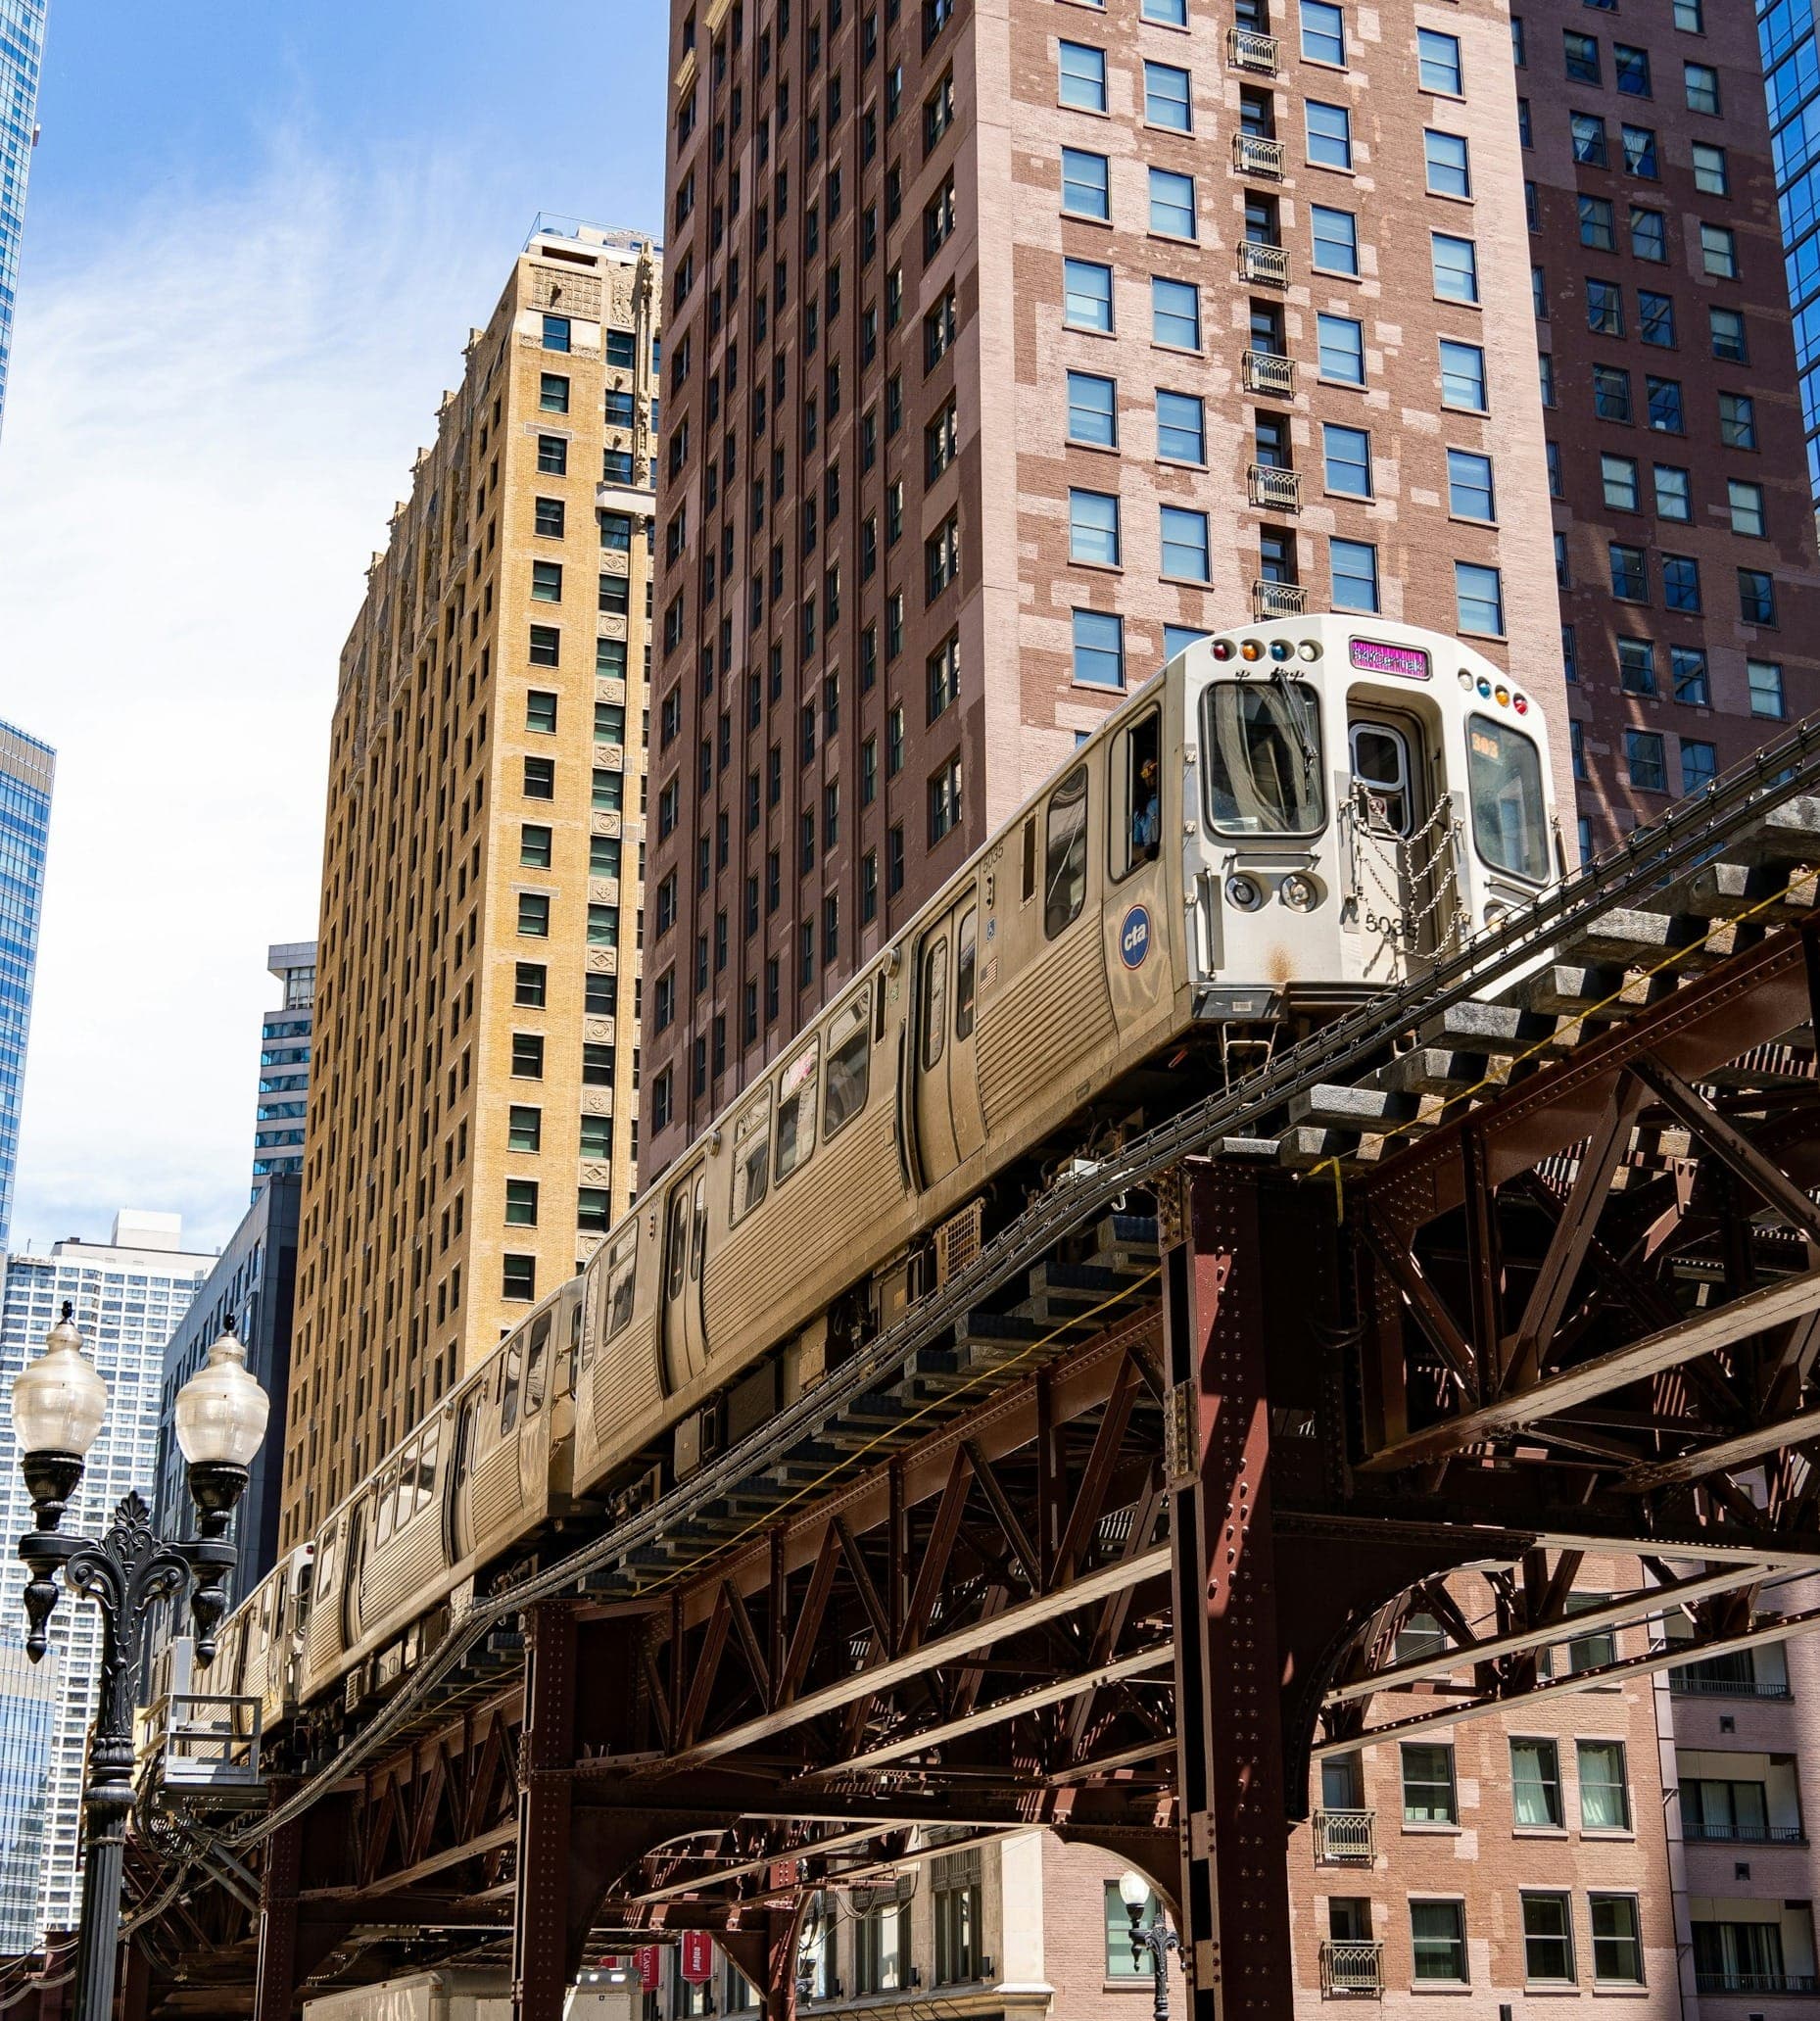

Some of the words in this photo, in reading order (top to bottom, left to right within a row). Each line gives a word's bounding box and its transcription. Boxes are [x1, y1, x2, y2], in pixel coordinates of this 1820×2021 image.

[982, 842, 1004, 873] 5035
[1124, 924, 1146, 951] cta
[1365, 913, 1417, 938] 5035
